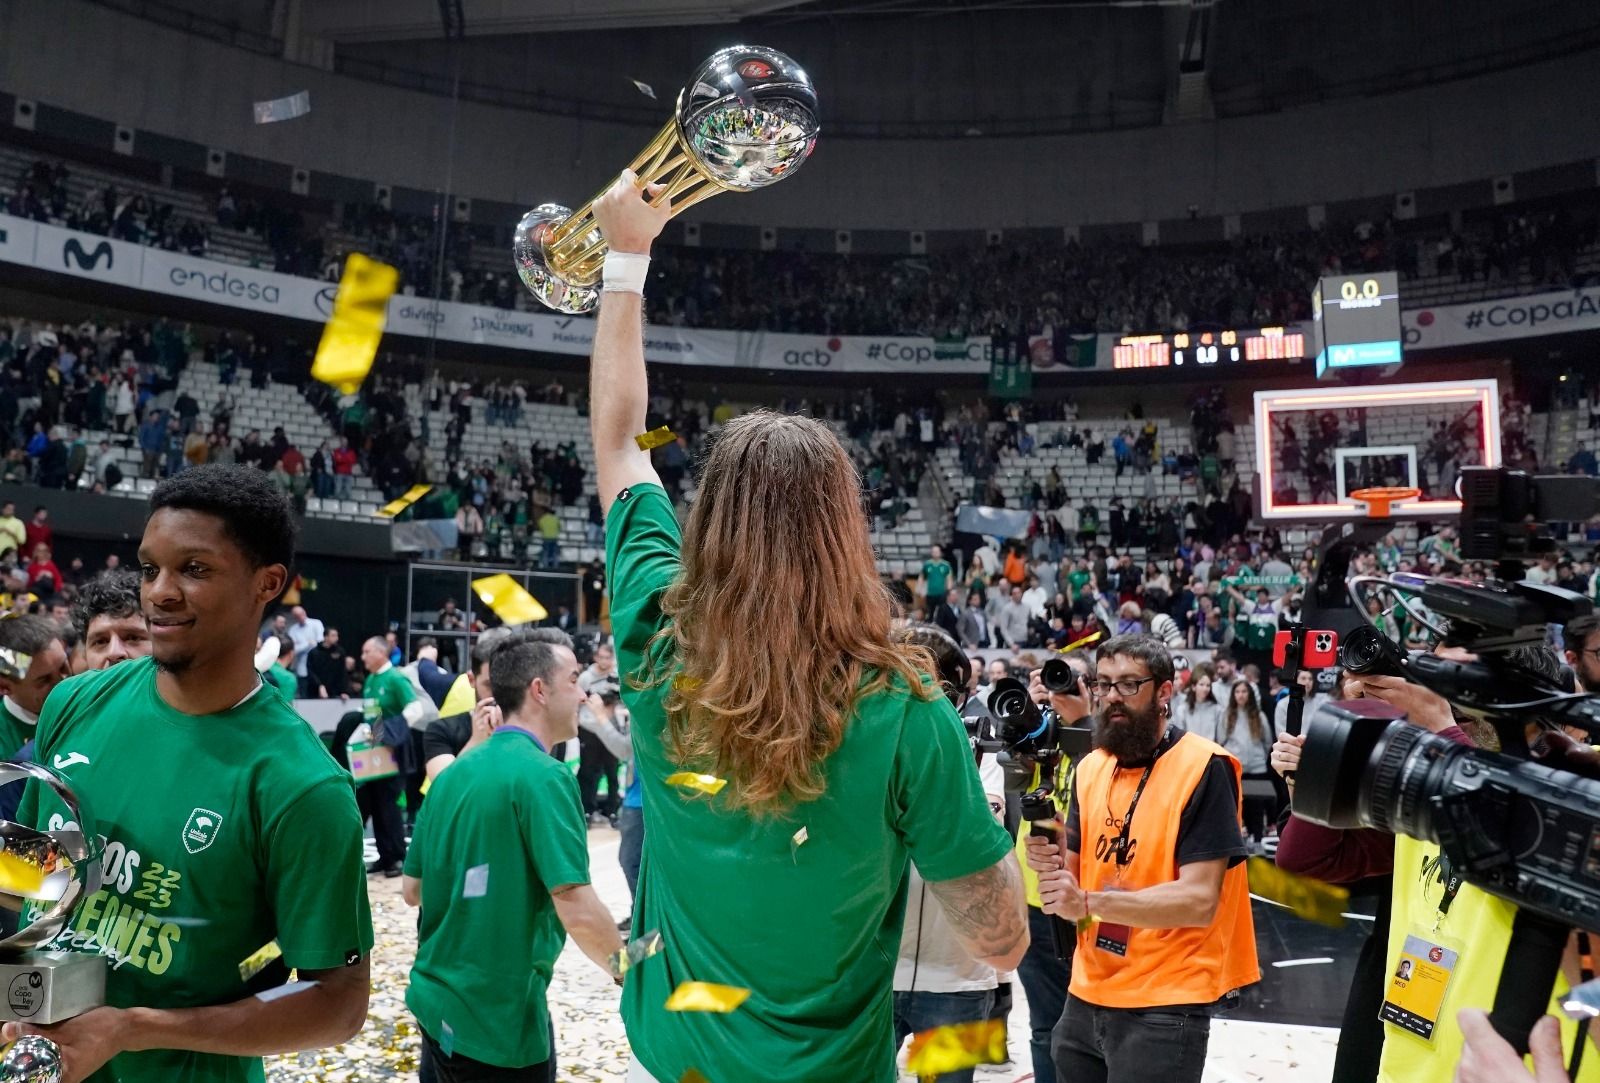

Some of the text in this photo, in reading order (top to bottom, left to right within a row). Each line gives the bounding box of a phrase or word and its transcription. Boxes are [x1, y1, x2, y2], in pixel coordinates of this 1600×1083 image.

[170, 264, 280, 304] endesa
[1341, 279, 1379, 301] 0.0
[1465, 295, 1600, 329] #CopaA
[783, 348, 831, 367] acb
[142, 862, 182, 889] 22
[133, 881, 172, 908] 23
